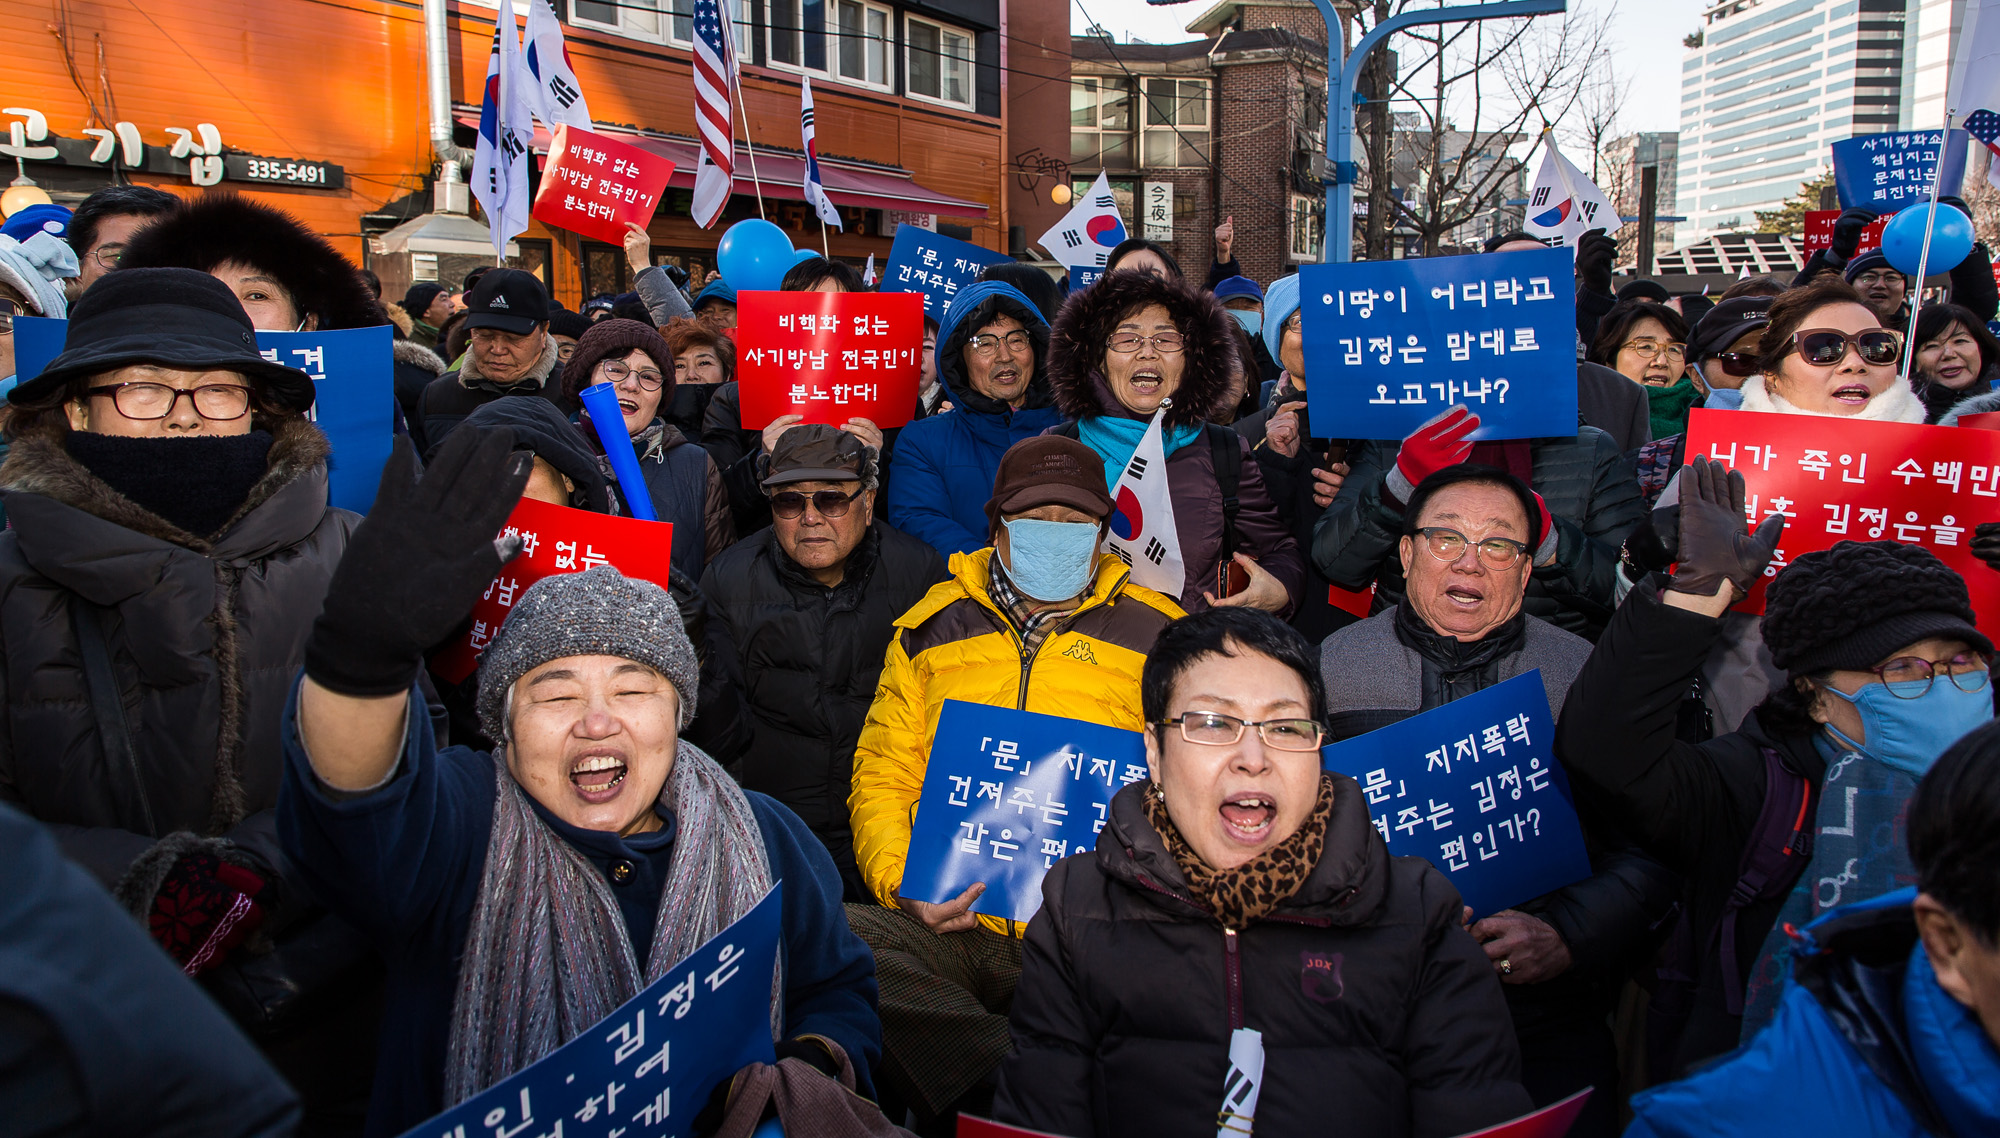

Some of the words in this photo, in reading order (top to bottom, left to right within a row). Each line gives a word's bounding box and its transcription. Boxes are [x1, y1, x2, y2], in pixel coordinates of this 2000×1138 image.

[0, 107, 225, 187] 고기집
[570, 144, 608, 166] 비핵화
[612, 158, 640, 179] 없는
[1871, 150, 1937, 168] 책임지고
[248, 159, 326, 184] 335-5491
[550, 164, 593, 190] 사기방남
[598, 179, 653, 208] 전국민이
[1873, 167, 1936, 186] 문재인은
[563, 194, 616, 222] 분노한다!
[1151, 185, 1166, 221] 今夜
[1872, 184, 1934, 200] 퇴진하라
[917, 246, 943, 270] 「문」
[954, 258, 988, 278] 지지
[898, 264, 958, 296] 건져주는
[1322, 285, 1407, 319] 이땅이
[1430, 276, 1555, 311] 어디라고
[778, 313, 841, 336] 비핵화
[853, 314, 890, 336] 없는
[745, 347, 829, 370] 사기방남
[841, 347, 915, 370] 전국민이
[1339, 333, 1427, 366] 김정은
[1446, 327, 1540, 362] 맘대로
[788, 383, 877, 404] 분노한다!
[1368, 377, 1510, 406] 오고가냐?
[1710, 442, 1777, 471] 니가
[1798, 449, 1867, 484] 죽인
[1891, 458, 2000, 498] 수백만
[1823, 503, 1965, 546] 김정은을
[555, 540, 609, 570] 없는
[980, 736, 1031, 776] 「문」
[1058, 752, 1148, 787] 지지폭
[1352, 767, 1407, 805] 문」
[1425, 712, 1531, 774] 지지폭락
[948, 775, 1069, 826] 건져주는
[1371, 798, 1454, 843] 져주는
[1470, 757, 1549, 814] 김정은
[960, 821, 1019, 861] 같은
[1440, 808, 1540, 872] 편인가?
[1306, 958, 1332, 971] JDX
[606, 944, 745, 1066] 김정은
